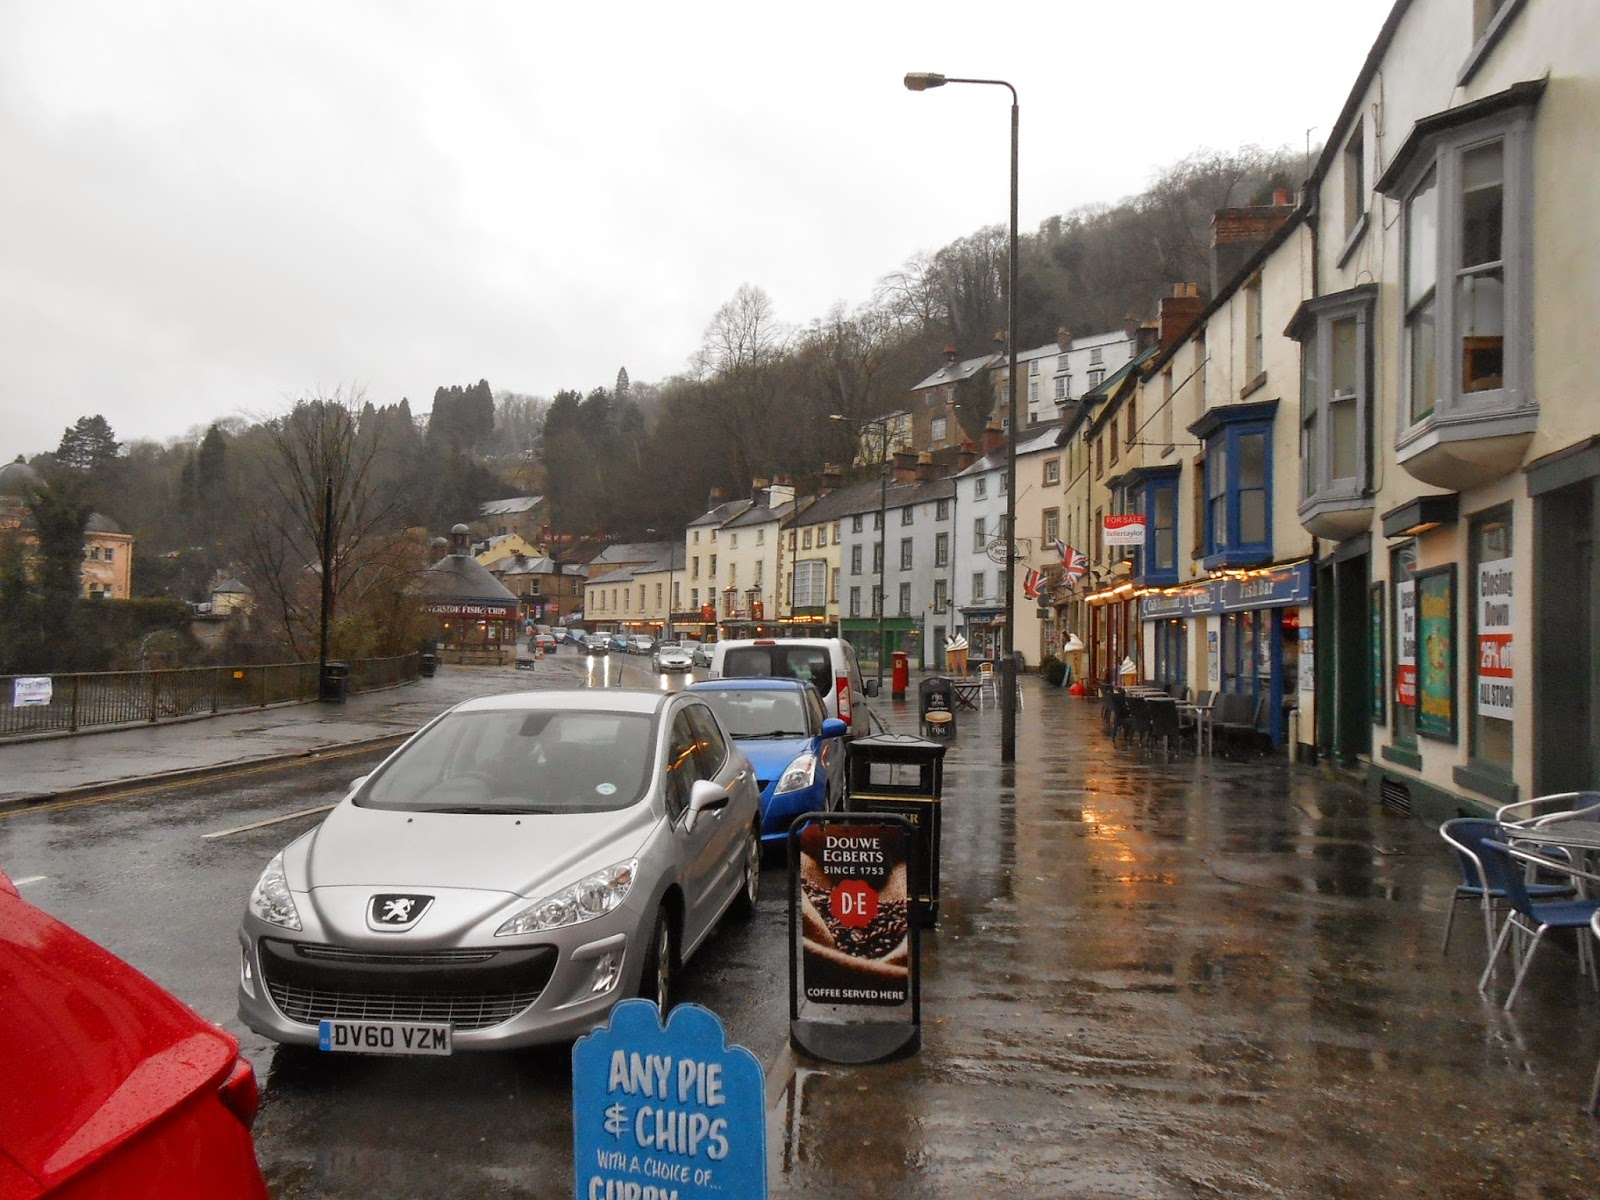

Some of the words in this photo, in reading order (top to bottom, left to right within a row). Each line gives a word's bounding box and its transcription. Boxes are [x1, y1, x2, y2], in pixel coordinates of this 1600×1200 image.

[1106, 516, 1122, 524] FOR
[1258, 579, 1275, 596] Bar
[1481, 569, 1513, 598] Closing
[462, 604, 481, 615] FISH
[488, 606, 507, 615] CHIPS
[1485, 601, 1510, 627] Down
[826, 836, 880, 850] DOUWE
[823, 849, 884, 863] EGBERTS
[823, 866, 856, 875] SINCE
[860, 866, 884, 876] 1753
[807, 988, 841, 998] COFFEE
[842, 989, 878, 999] SERVED
[880, 990, 905, 1000] HERE
[334, 1024, 394, 1048] DV60
[401, 1027, 447, 1050] VZM
[607, 1049, 672, 1100] ANY
[677, 1058, 726, 1108] PIE
[603, 1102, 630, 1140] &
[635, 1105, 730, 1161] CHIPS
[597, 1148, 627, 1172] WITH
[629, 1156, 641, 1173] A
[643, 1157, 691, 1184] CHOICE
